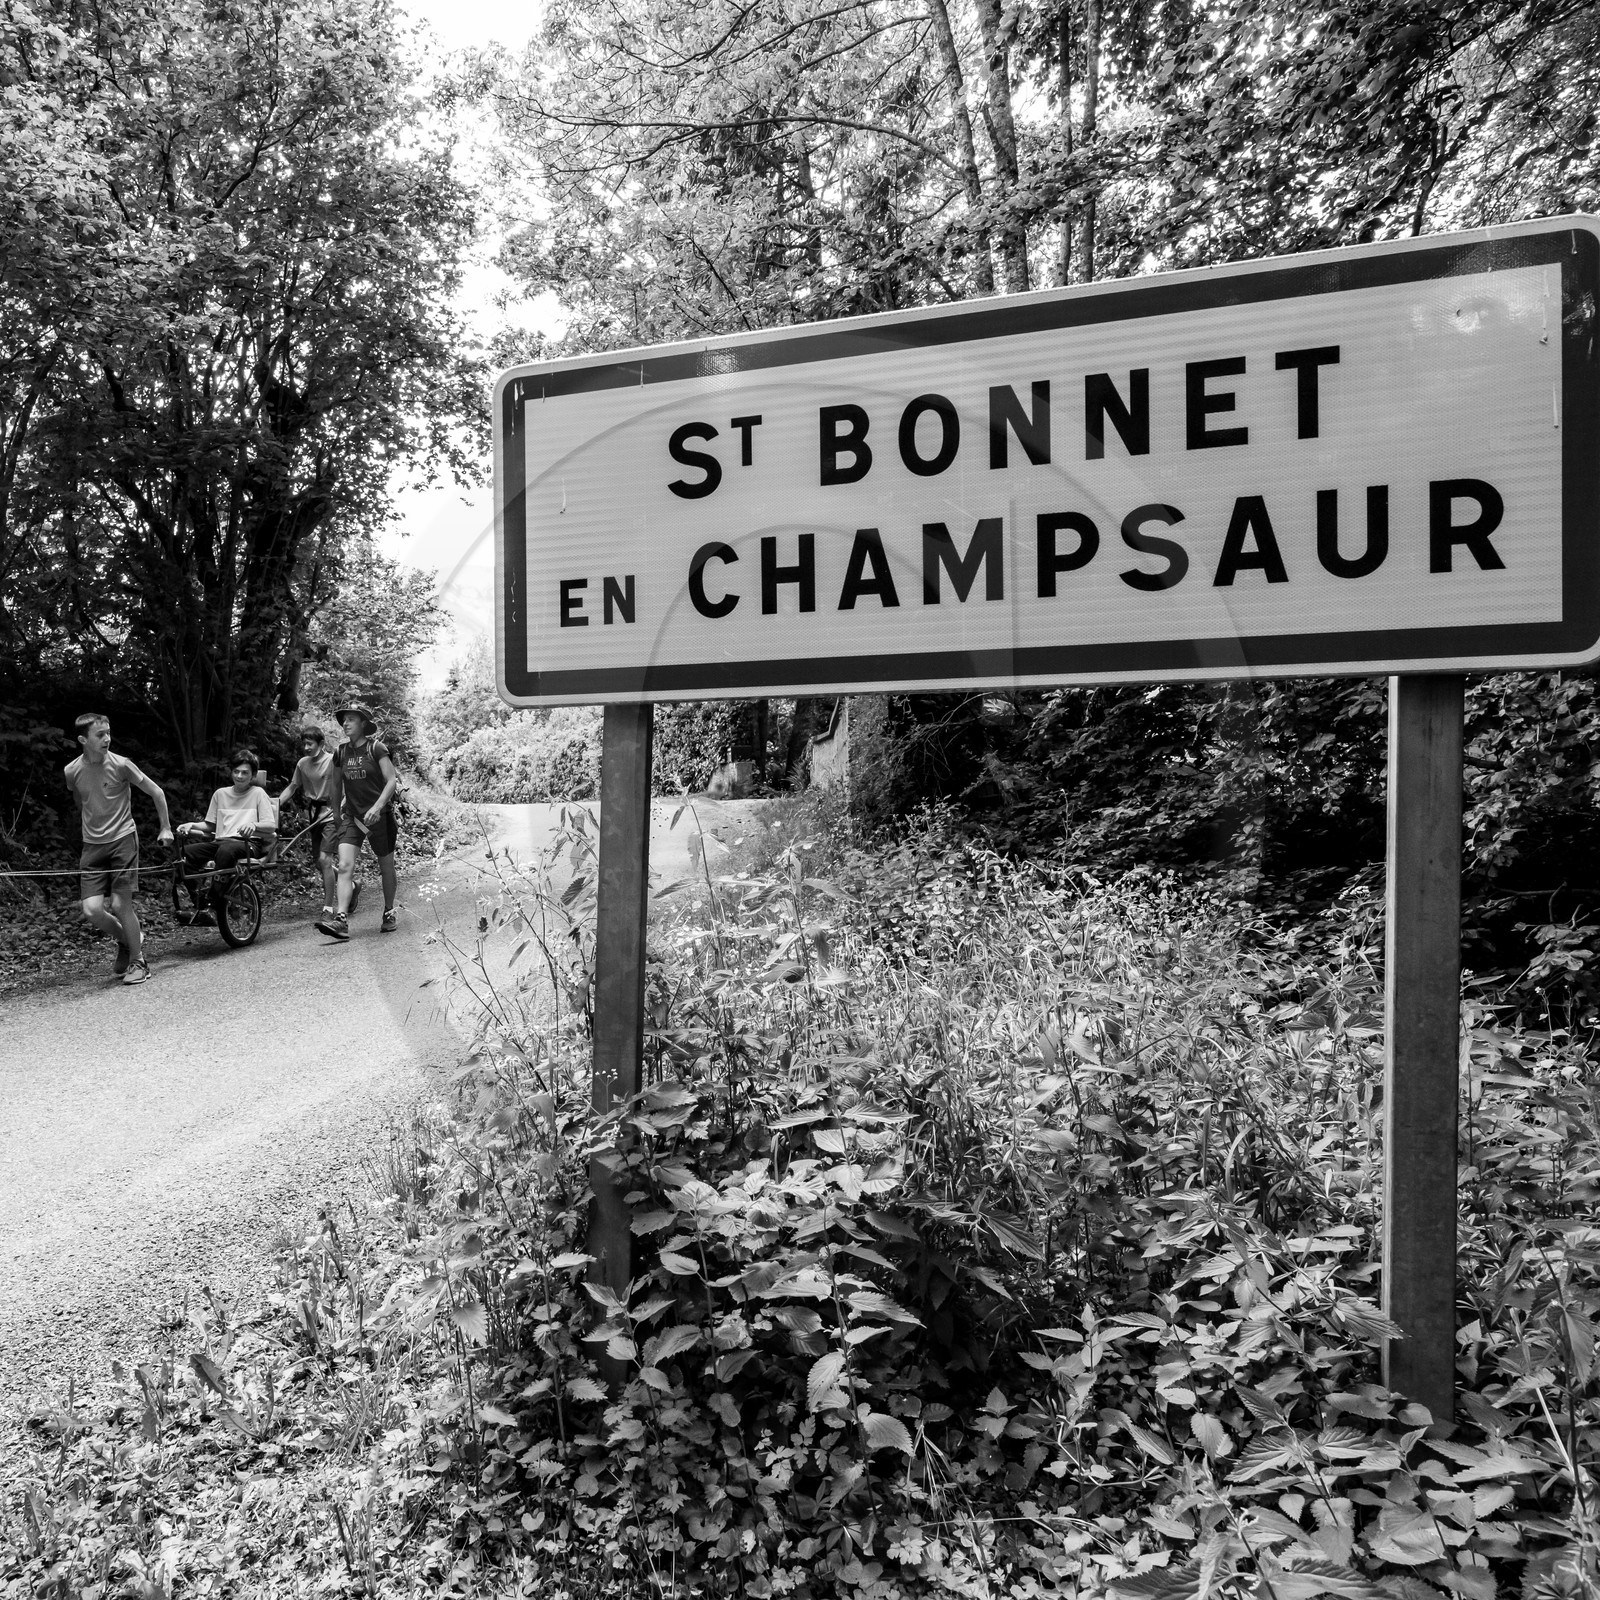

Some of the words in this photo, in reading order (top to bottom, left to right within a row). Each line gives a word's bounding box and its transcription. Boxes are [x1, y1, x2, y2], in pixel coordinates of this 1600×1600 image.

[819, 344, 1341, 487] BONNET
[559, 574, 636, 628] EN
[688, 478, 1507, 619] CHAMPSAUR
